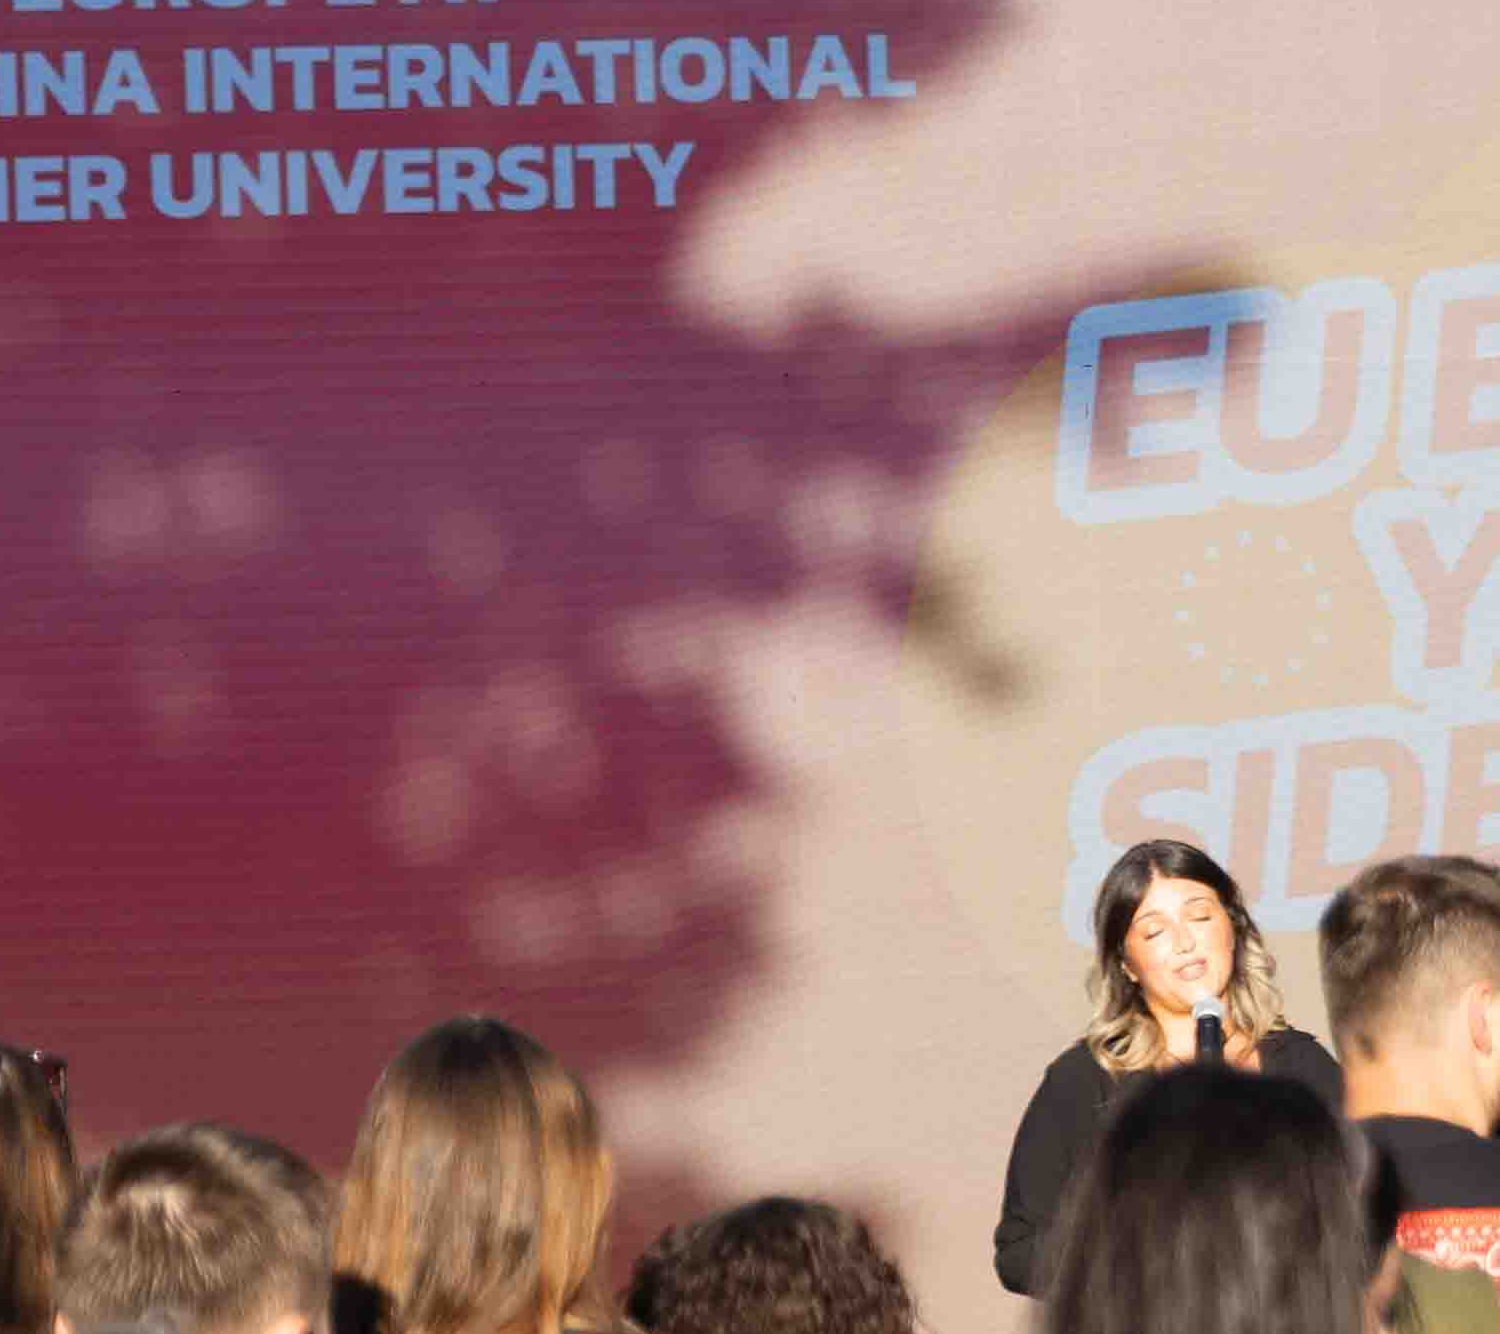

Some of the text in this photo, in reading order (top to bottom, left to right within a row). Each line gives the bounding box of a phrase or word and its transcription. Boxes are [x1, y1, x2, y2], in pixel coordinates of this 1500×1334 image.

[183, 33, 918, 115] INTERNATIONAL
[149, 140, 696, 221] UNIVERSITY
[1076, 299, 1372, 497] EU
